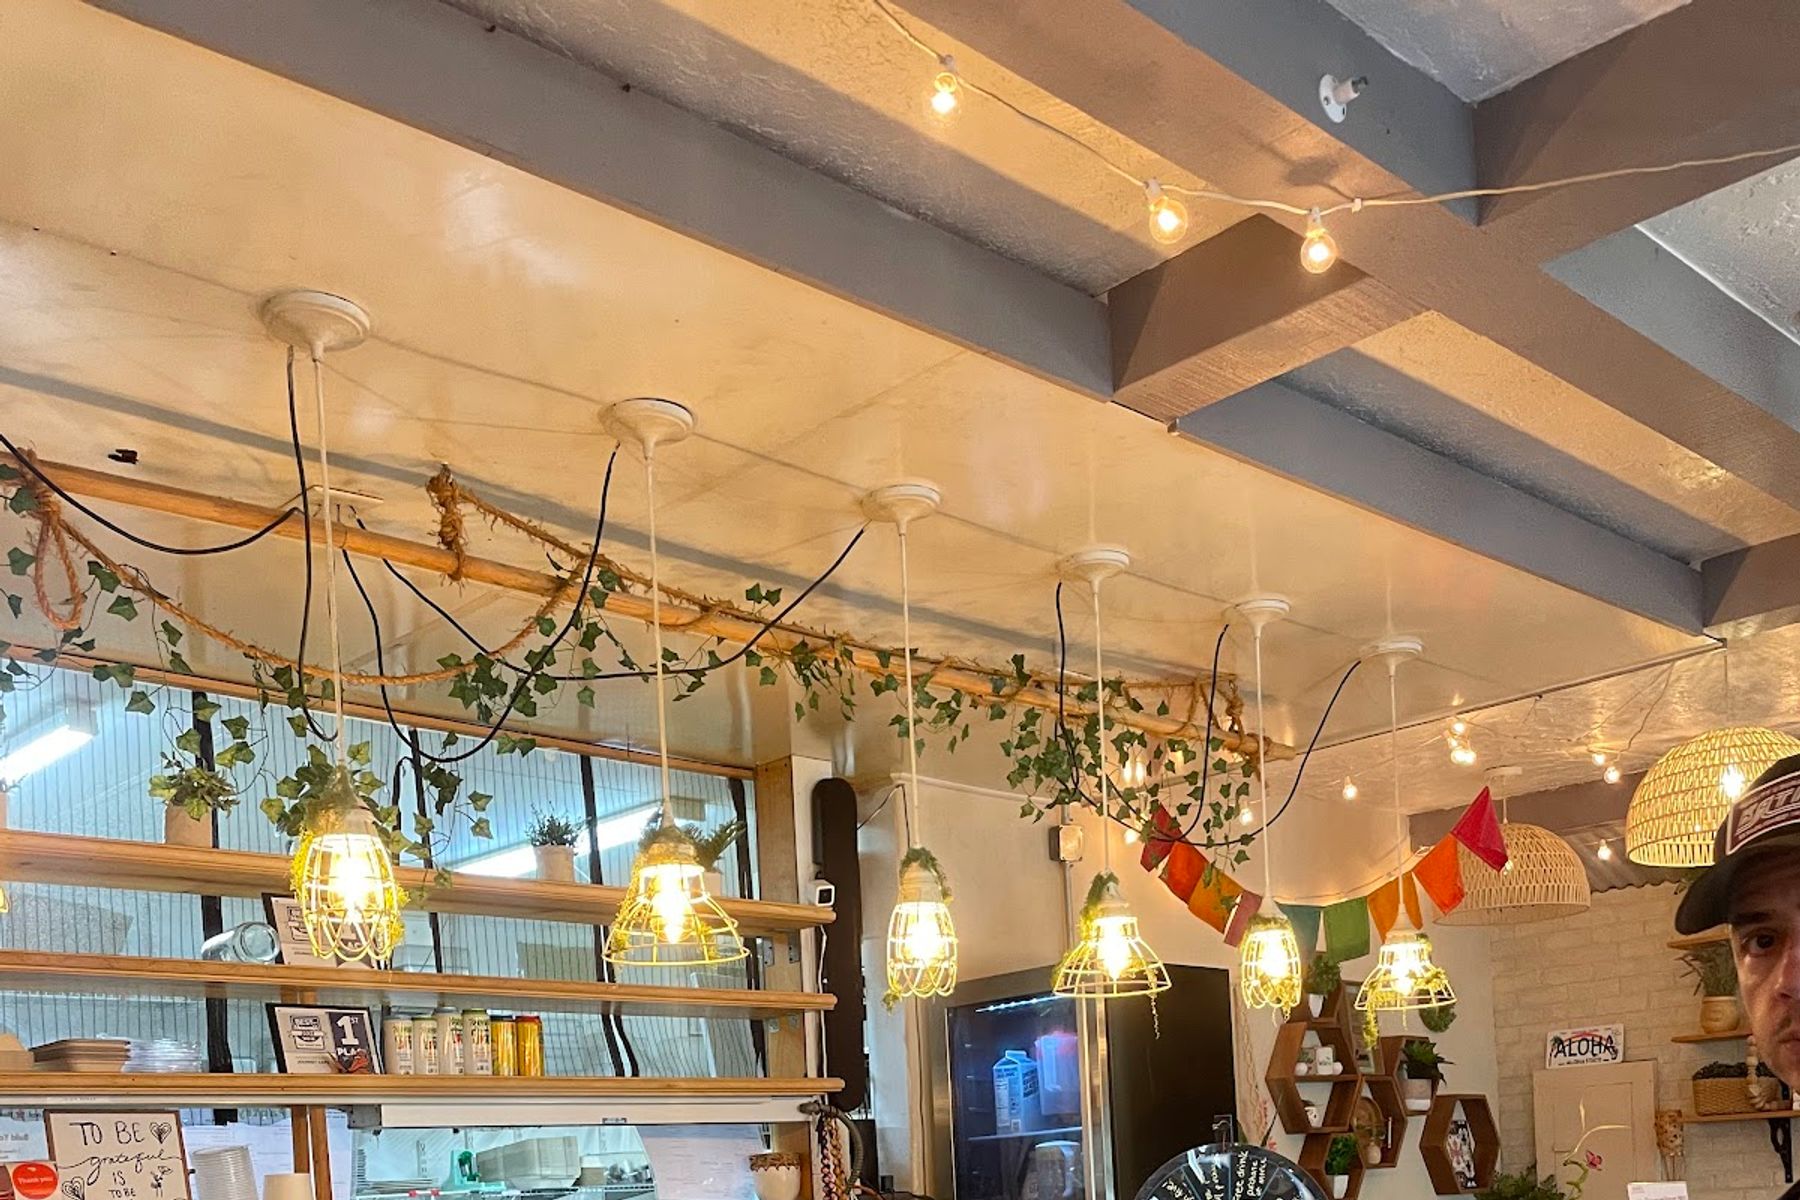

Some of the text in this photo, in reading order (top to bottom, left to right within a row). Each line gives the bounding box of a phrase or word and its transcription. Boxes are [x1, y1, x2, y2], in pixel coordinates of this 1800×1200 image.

[1554, 1035, 1615, 1058] ALOHA
[69, 1120, 145, 1146] TO BE
[87, 1149, 169, 1186] grateful
